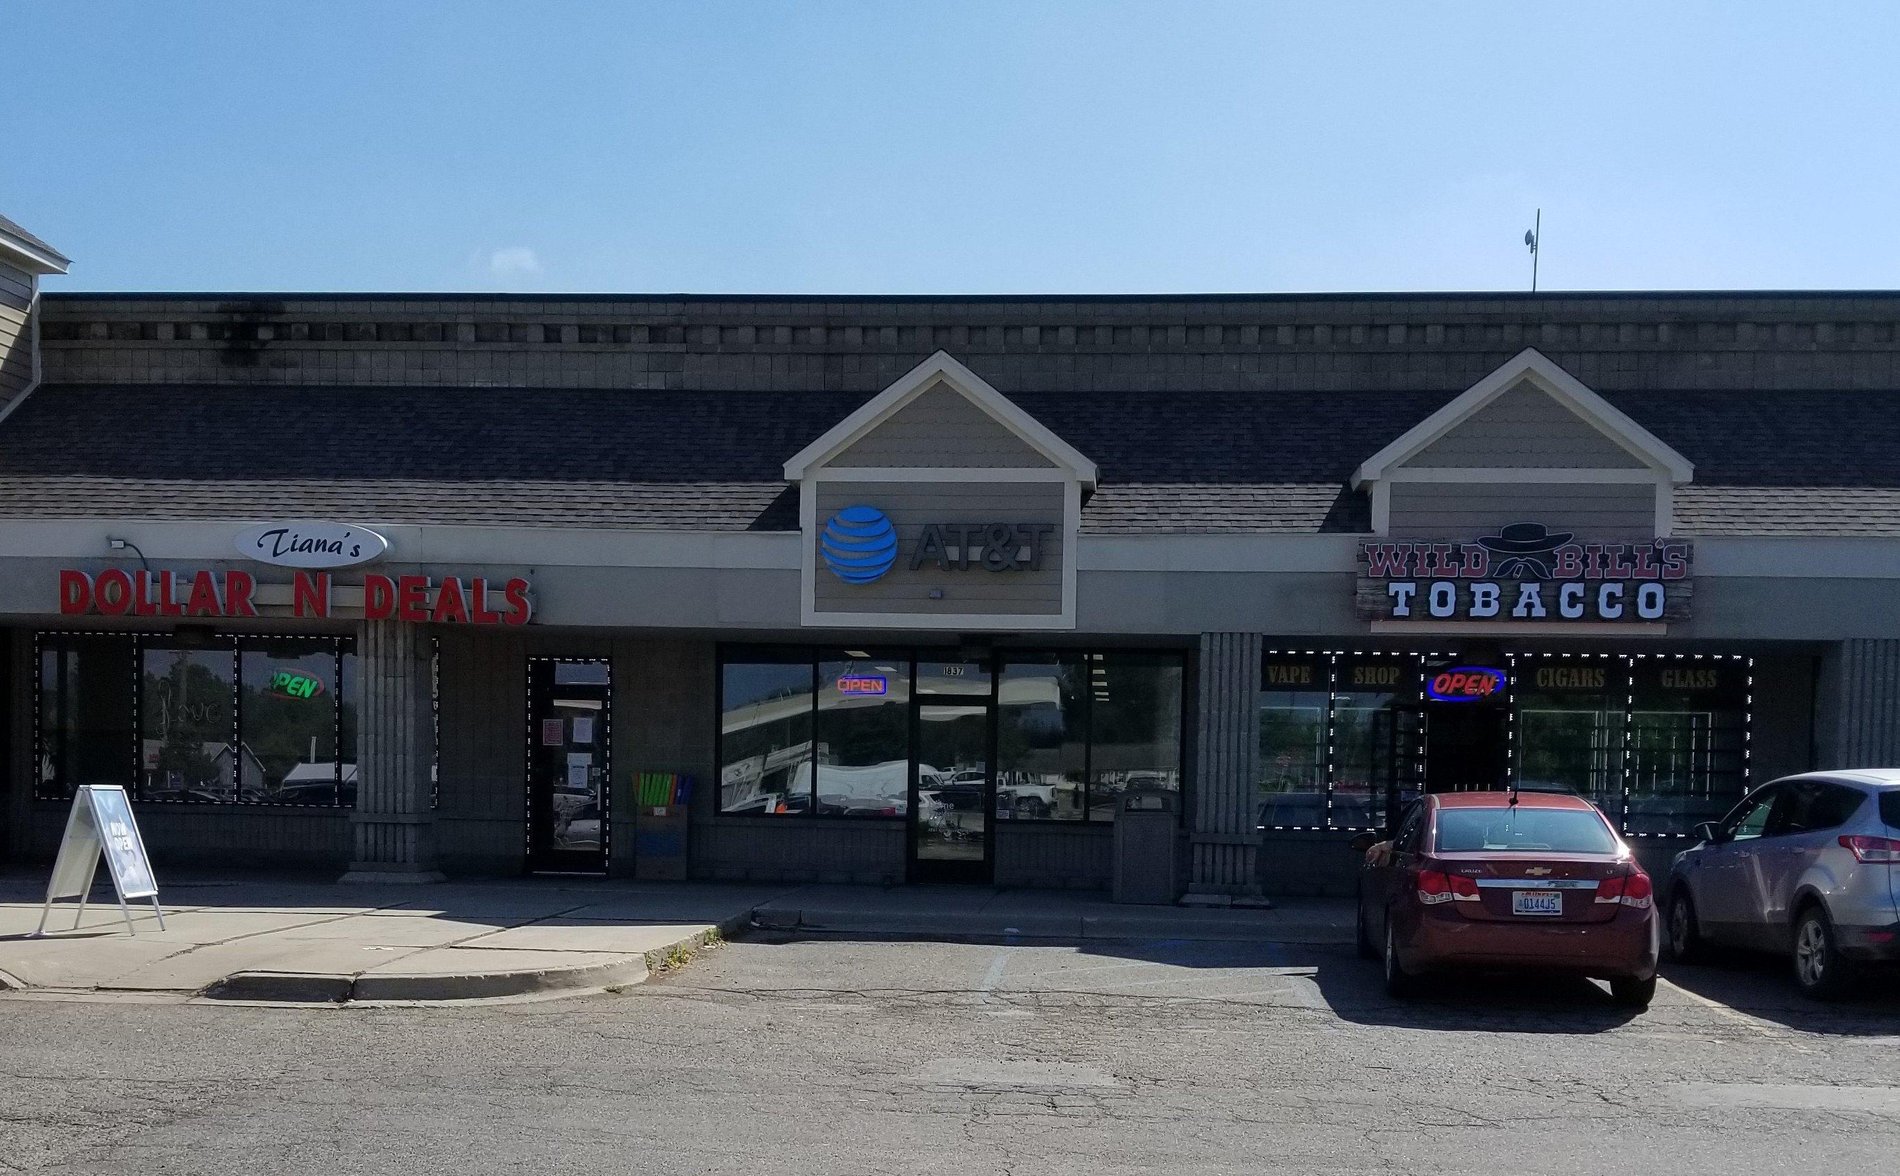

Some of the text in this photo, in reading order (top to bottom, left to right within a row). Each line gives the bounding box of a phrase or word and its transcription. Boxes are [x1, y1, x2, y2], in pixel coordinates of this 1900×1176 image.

[257, 529, 361, 558] Tiana's
[909, 523, 1054, 572] AT&T
[1365, 543, 1490, 578] WILD
[60, 568, 532, 627] DOLLAR N DEALS
[1388, 581, 1666, 619] TOBACCO
[944, 667, 964, 676] 1837
[1268, 665, 1310, 684] VAPE
[1354, 666, 1400, 685] SHOP
[1536, 667, 1605, 689] CIGARS
[1661, 669, 1717, 689] GLASS
[837, 678, 883, 692] OPEN
[1433, 673, 1497, 696] OPEN
